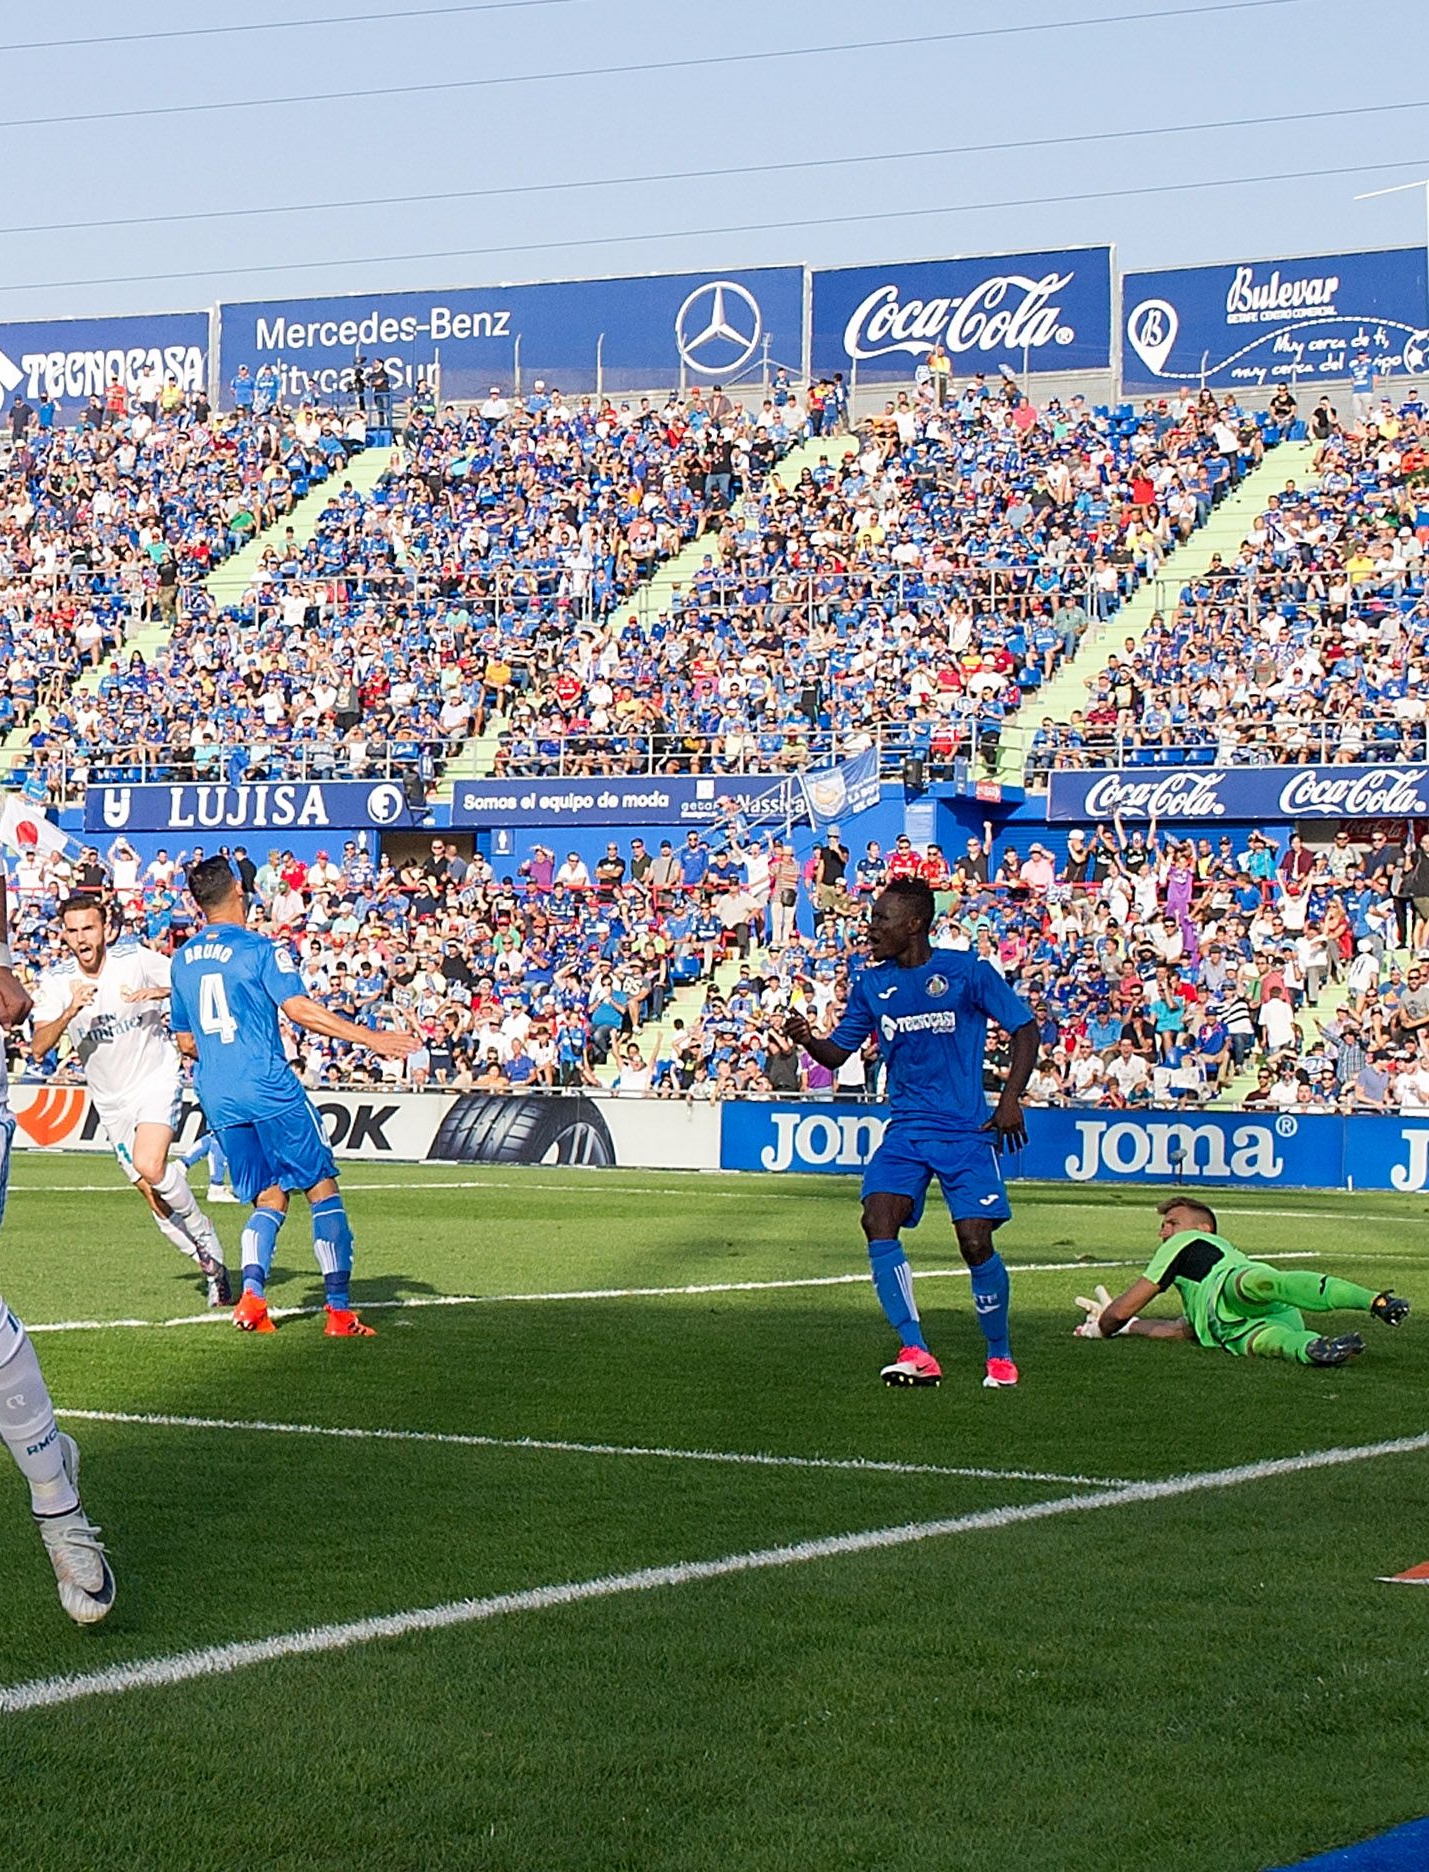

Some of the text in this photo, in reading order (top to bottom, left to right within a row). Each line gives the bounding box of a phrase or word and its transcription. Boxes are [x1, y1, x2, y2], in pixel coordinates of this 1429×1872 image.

[1226, 266, 1339, 313] Bulevar
[257, 307, 510, 350] Mercedes-Benz
[844, 272, 1074, 359] Coca-Cola
[1351, 327, 1370, 347] de
[1319, 352, 1345, 370] del
[171, 784, 330, 827] LUJISA
[463, 790, 670, 813] Somos el equipo de moda
[1085, 772, 1227, 816] Coca-Cola
[1279, 769, 1428, 814] Coca-Cola
[184, 943, 233, 965] BRUNO
[199, 972, 237, 1044] 4
[761, 1113, 892, 1171] Jom
[1065, 1121, 1284, 1181] Joma
